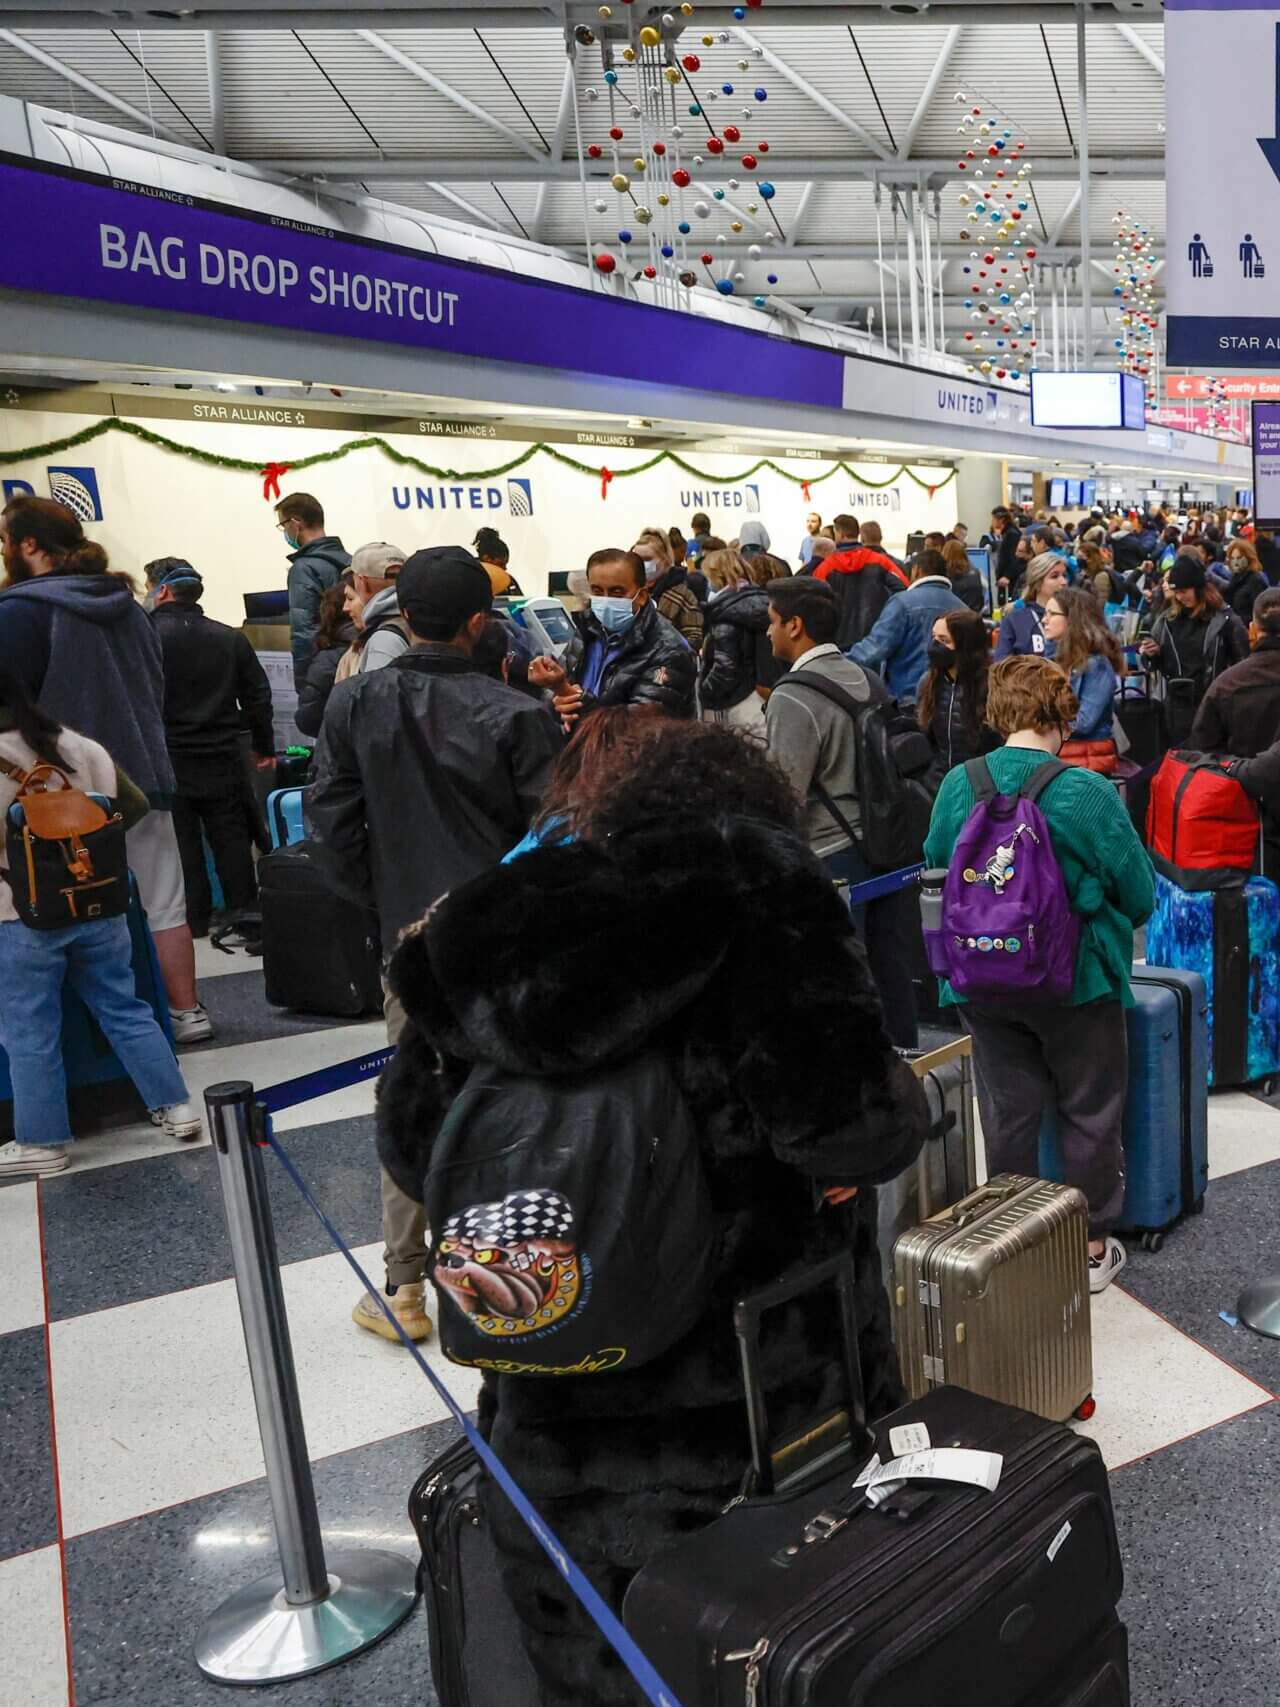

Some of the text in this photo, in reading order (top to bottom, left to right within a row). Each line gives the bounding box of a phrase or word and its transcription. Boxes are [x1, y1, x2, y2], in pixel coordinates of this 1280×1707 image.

[112, 179, 184, 204] STAR ALLIANCE
[270, 216, 326, 237] STAR ALLIANCE
[100, 223, 459, 326] BAG DROP SHORTCUT
[1219, 336, 1260, 349] STAR
[1215, 382, 1257, 396] curity
[938, 390, 984, 414] UNITED
[193, 404, 292, 423] STAR ALLIANCE
[419, 421, 487, 437] STAR ALLIANCE
[576, 433, 628, 446] STAR ALLIANCE
[1260, 442, 1278, 450] your
[392, 486, 503, 509] UNITED
[680, 490, 743, 507] UNITED
[849, 492, 889, 506] UNITED
